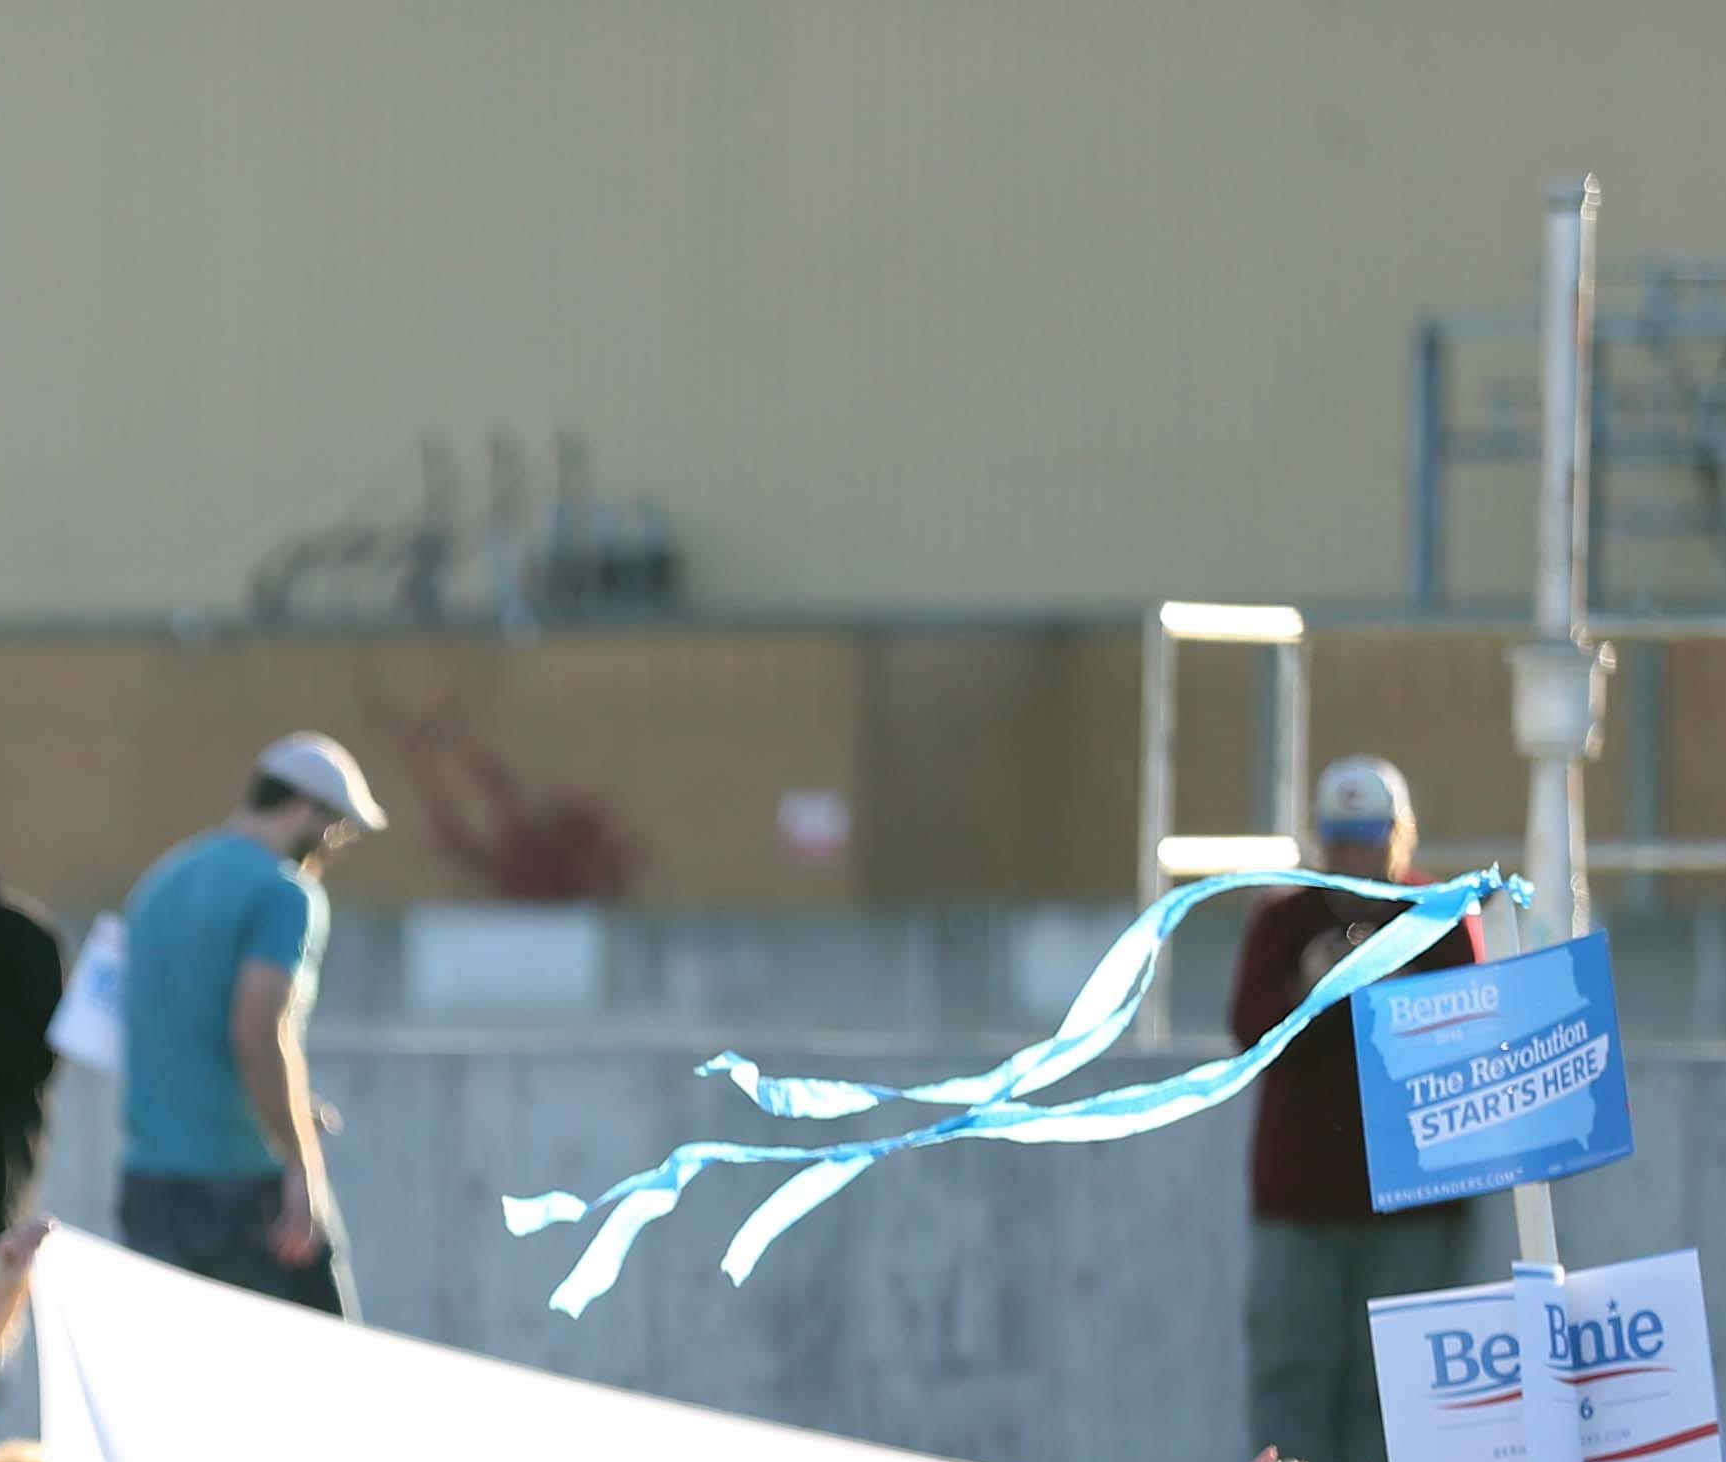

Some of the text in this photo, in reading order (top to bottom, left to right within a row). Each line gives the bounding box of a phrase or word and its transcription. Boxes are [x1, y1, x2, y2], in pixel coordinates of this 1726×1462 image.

[1390, 980, 1500, 1029] Bernie
[1406, 1019, 1589, 1106] The Revolution
[1422, 1047, 1599, 1142] STARTS HERE
